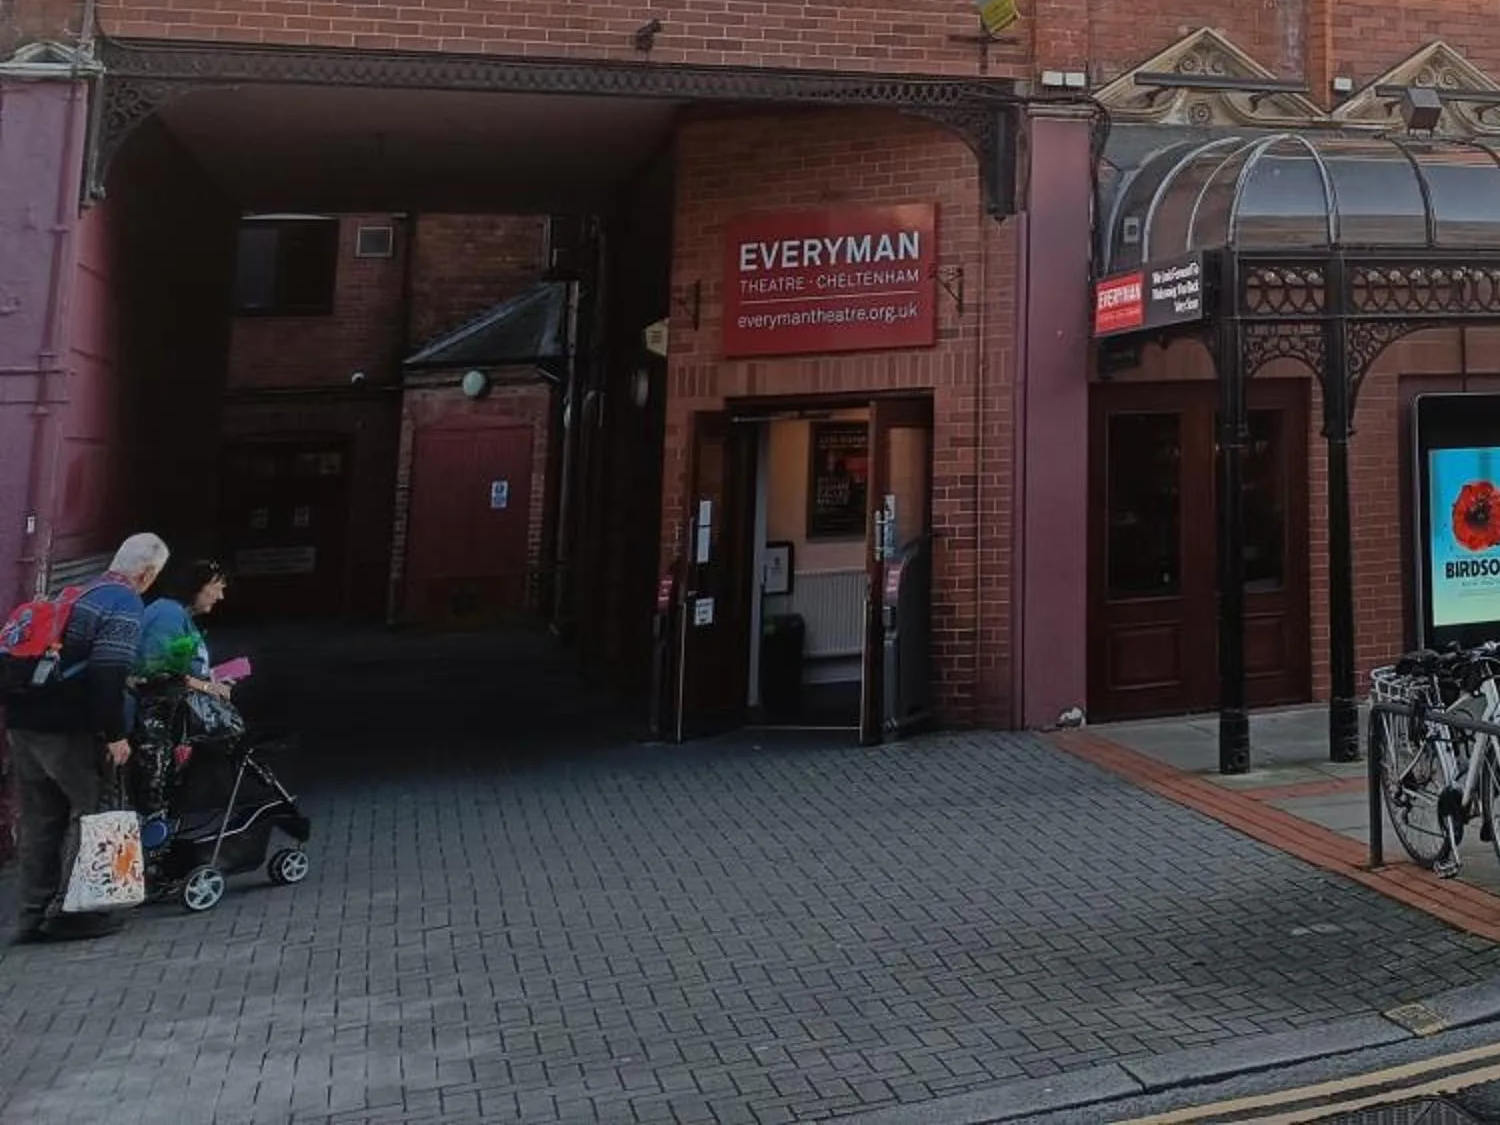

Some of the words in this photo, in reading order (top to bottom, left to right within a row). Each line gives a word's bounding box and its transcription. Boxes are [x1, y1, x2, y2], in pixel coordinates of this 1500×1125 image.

[739, 231, 920, 271] EVERYMAN
[739, 275, 805, 294] THEATRE
[817, 269, 920, 289] CHELTENHAM
[737, 302, 919, 330] everymantheatre.org.uk
